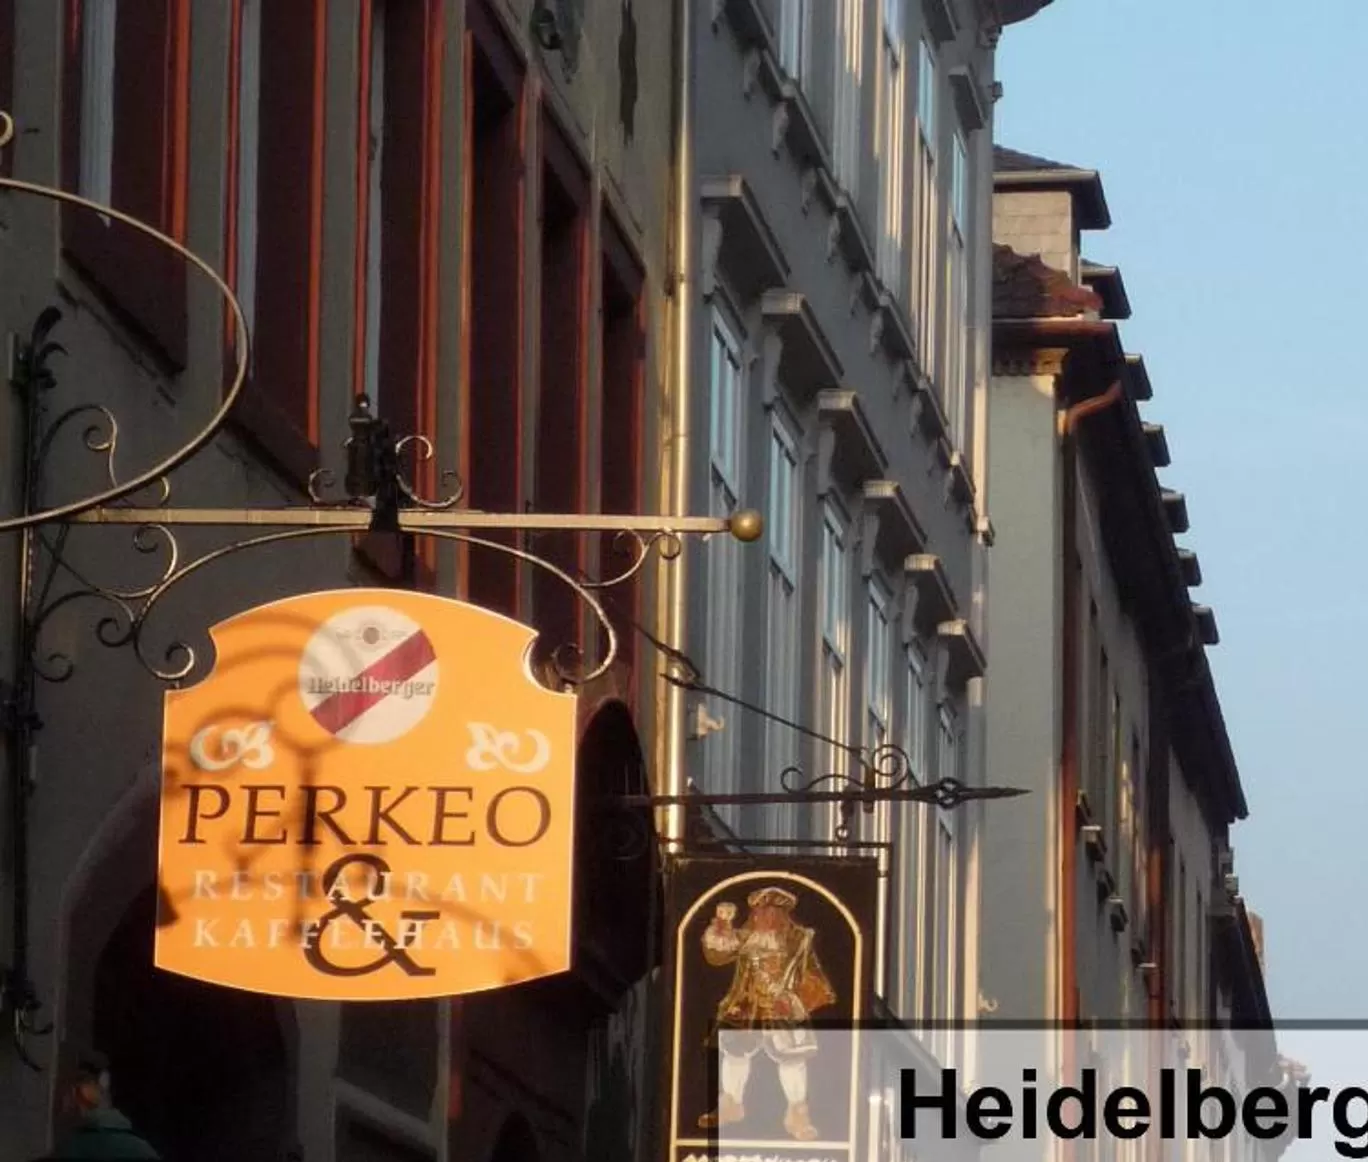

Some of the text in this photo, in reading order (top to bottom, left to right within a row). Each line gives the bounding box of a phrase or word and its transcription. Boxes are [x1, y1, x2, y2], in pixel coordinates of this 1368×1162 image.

[307, 676, 436, 700] Heidelberger
[179, 785, 552, 848] PERKEO
[194, 869, 545, 905] RESTAURANT
[195, 918, 534, 952] KAFFEEHAUS
